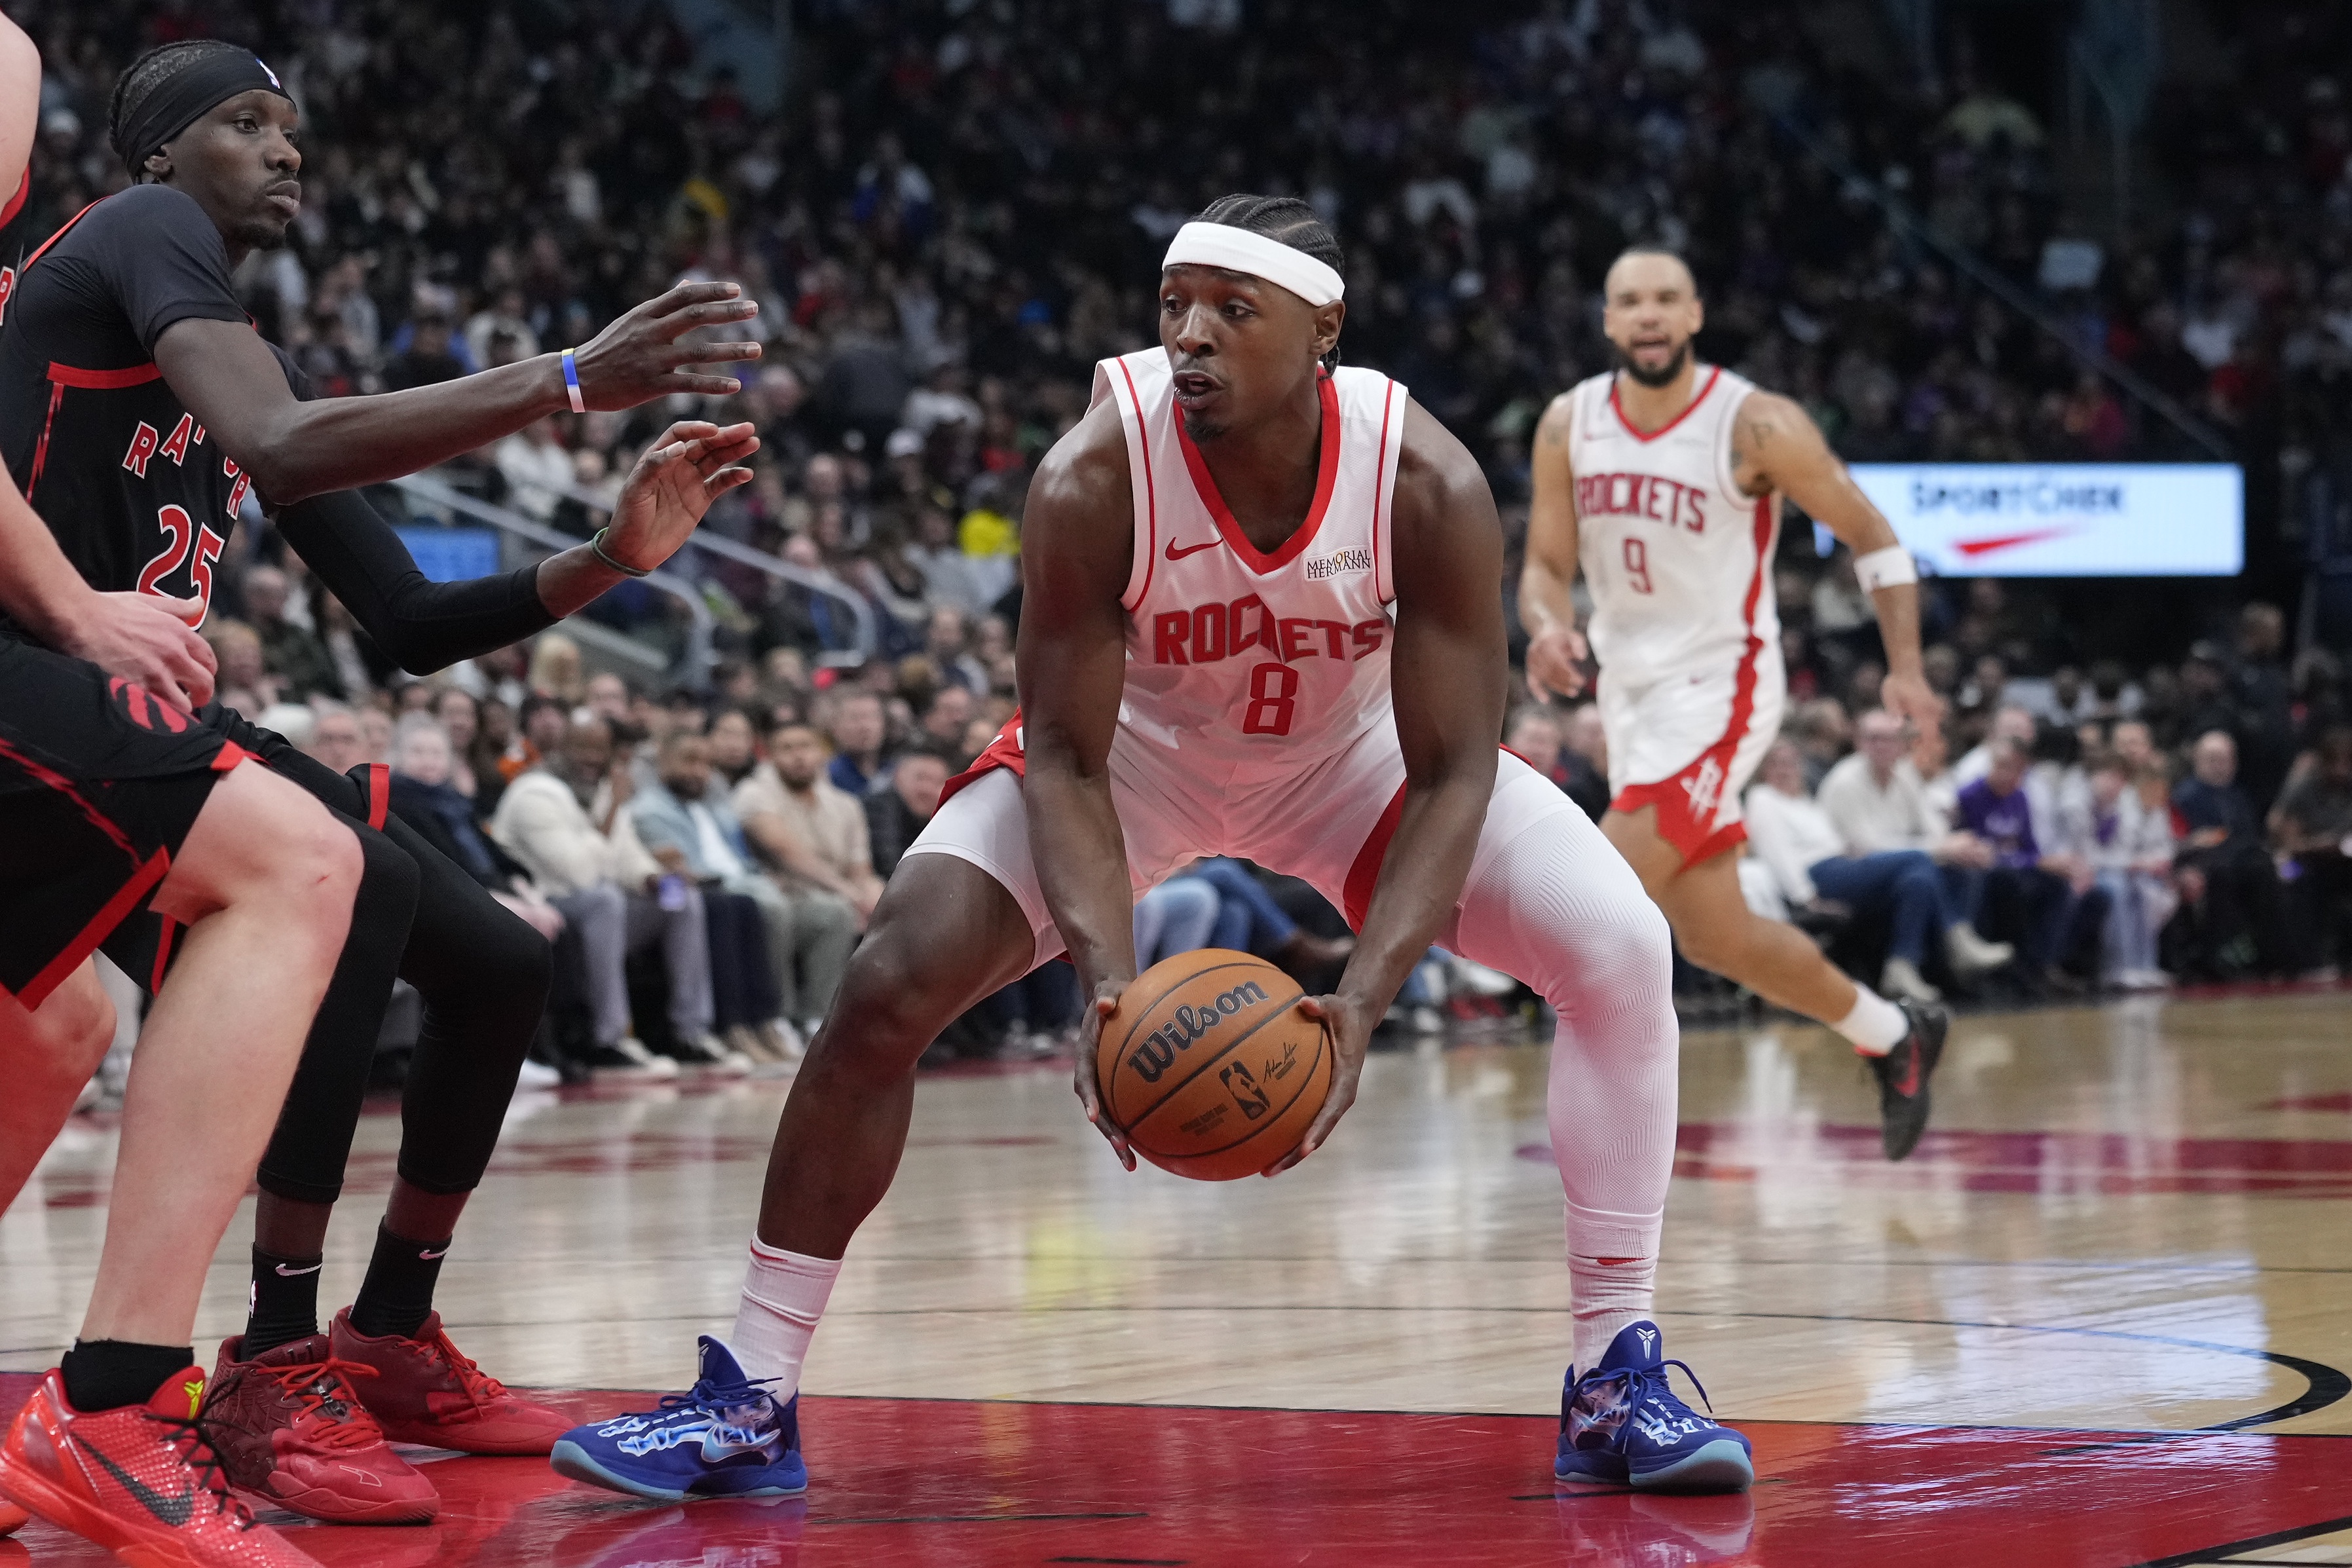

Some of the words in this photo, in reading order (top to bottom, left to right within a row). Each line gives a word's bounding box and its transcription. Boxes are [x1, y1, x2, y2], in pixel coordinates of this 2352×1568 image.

[1577, 472, 1706, 534] ROCKETS
[136, 504, 225, 629] 25
[1307, 550, 1371, 570] MEMORIAL
[1307, 559, 1371, 579] HERMANN
[1621, 536, 1655, 595] 9
[1242, 662, 1299, 736] 8
[1127, 980, 1269, 1083] Wilson
